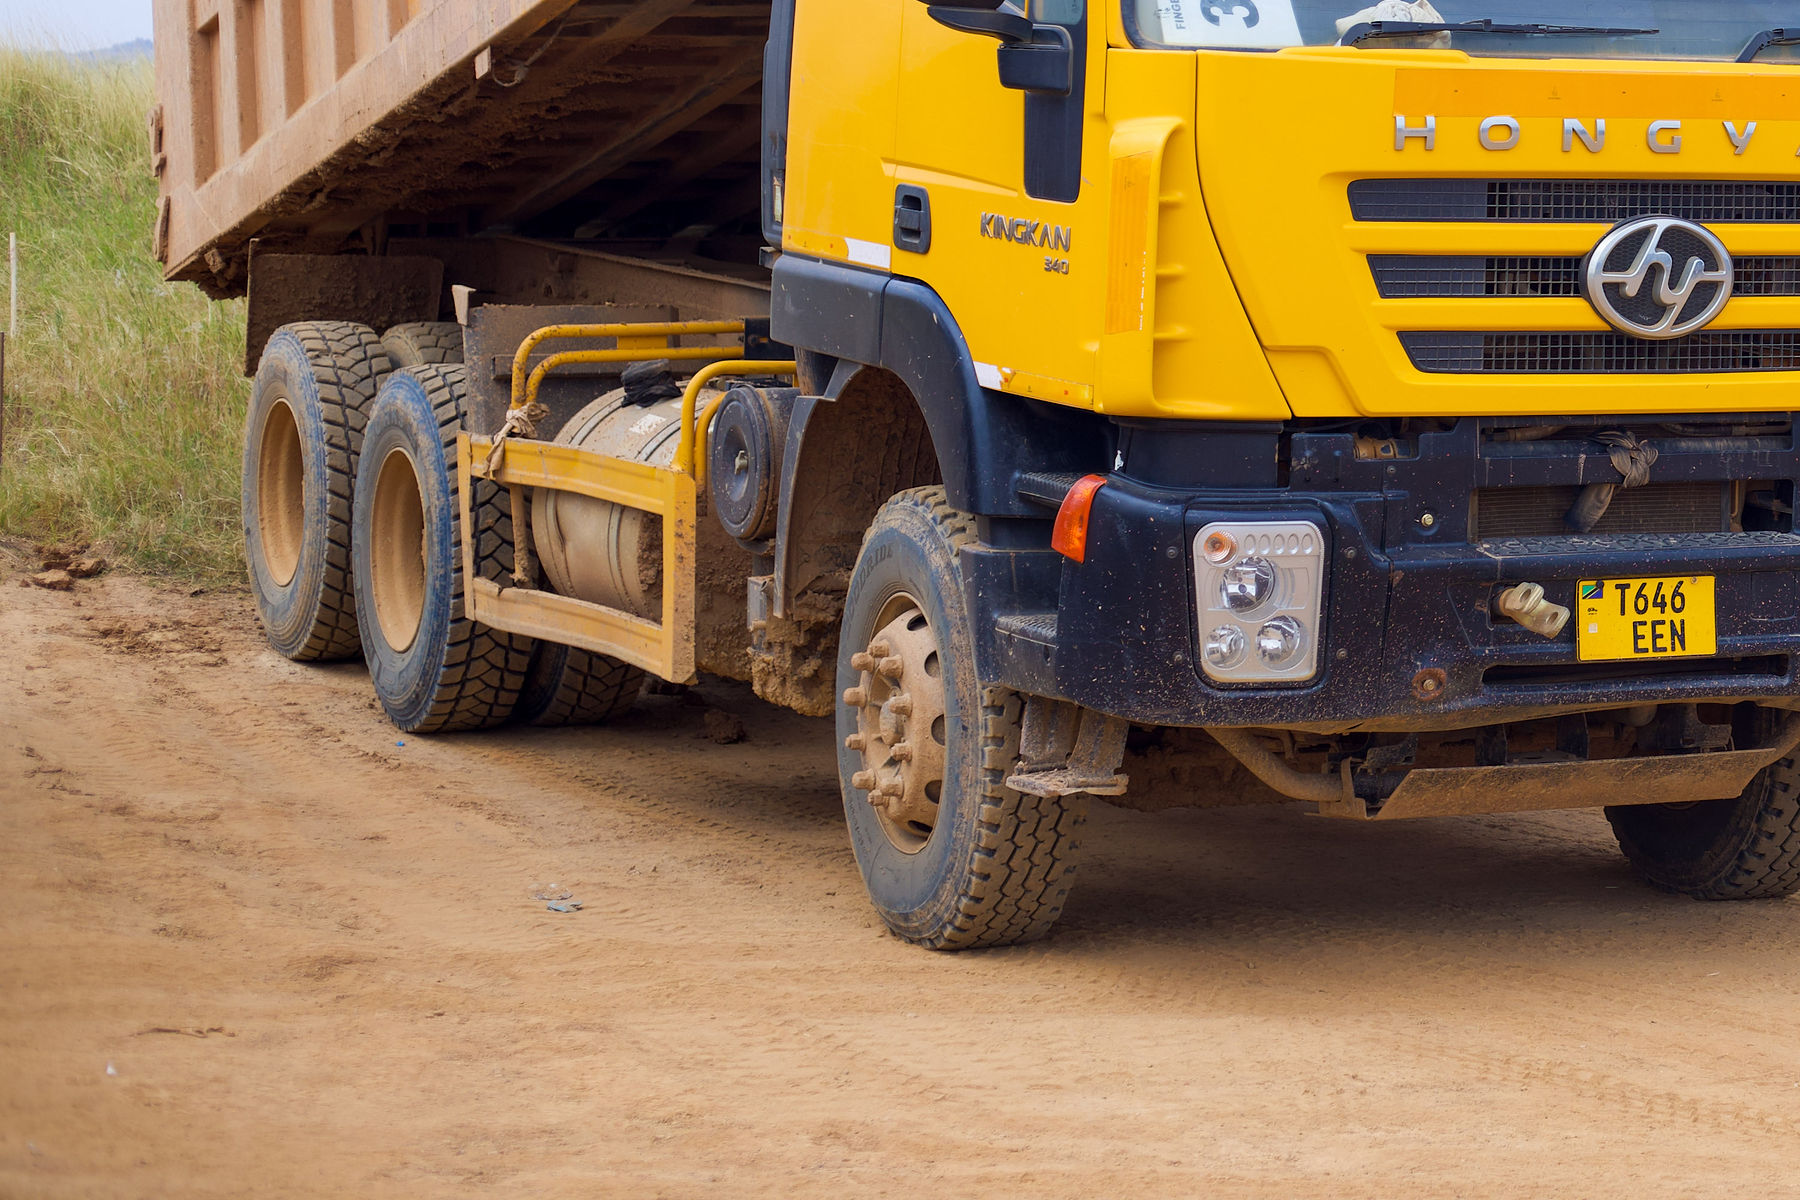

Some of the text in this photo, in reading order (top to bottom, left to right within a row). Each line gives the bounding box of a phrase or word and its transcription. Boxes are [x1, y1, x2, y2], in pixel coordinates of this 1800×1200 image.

[980, 211, 1071, 252] KINGKAN
[1044, 256, 1069, 275] 340
[1615, 581, 1686, 616] T646
[1633, 619, 1686, 653] EEN
